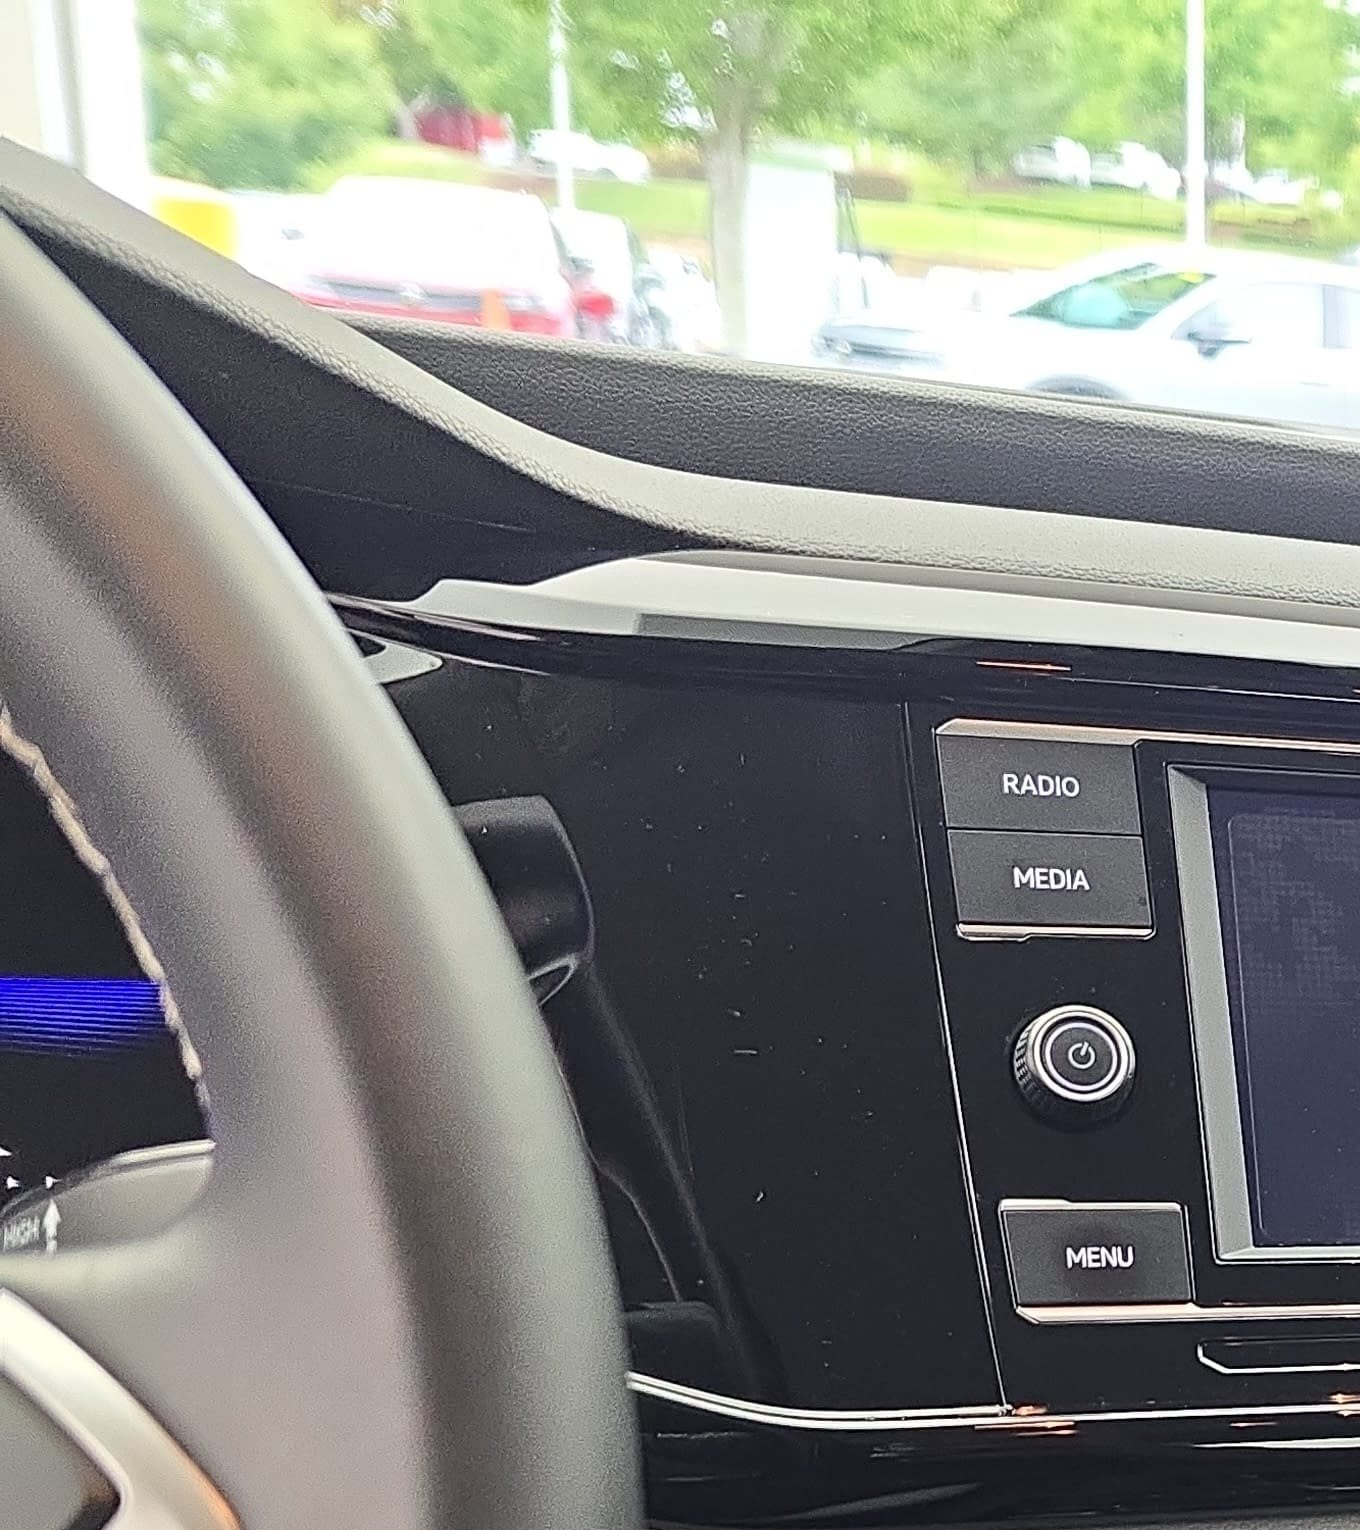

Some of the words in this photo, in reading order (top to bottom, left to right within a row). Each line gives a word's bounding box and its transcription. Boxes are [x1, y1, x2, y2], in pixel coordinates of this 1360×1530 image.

[1002, 773, 1080, 797] RADIO
[1013, 867, 1090, 891] MEDIA
[1066, 1245, 1135, 1269] MENU
